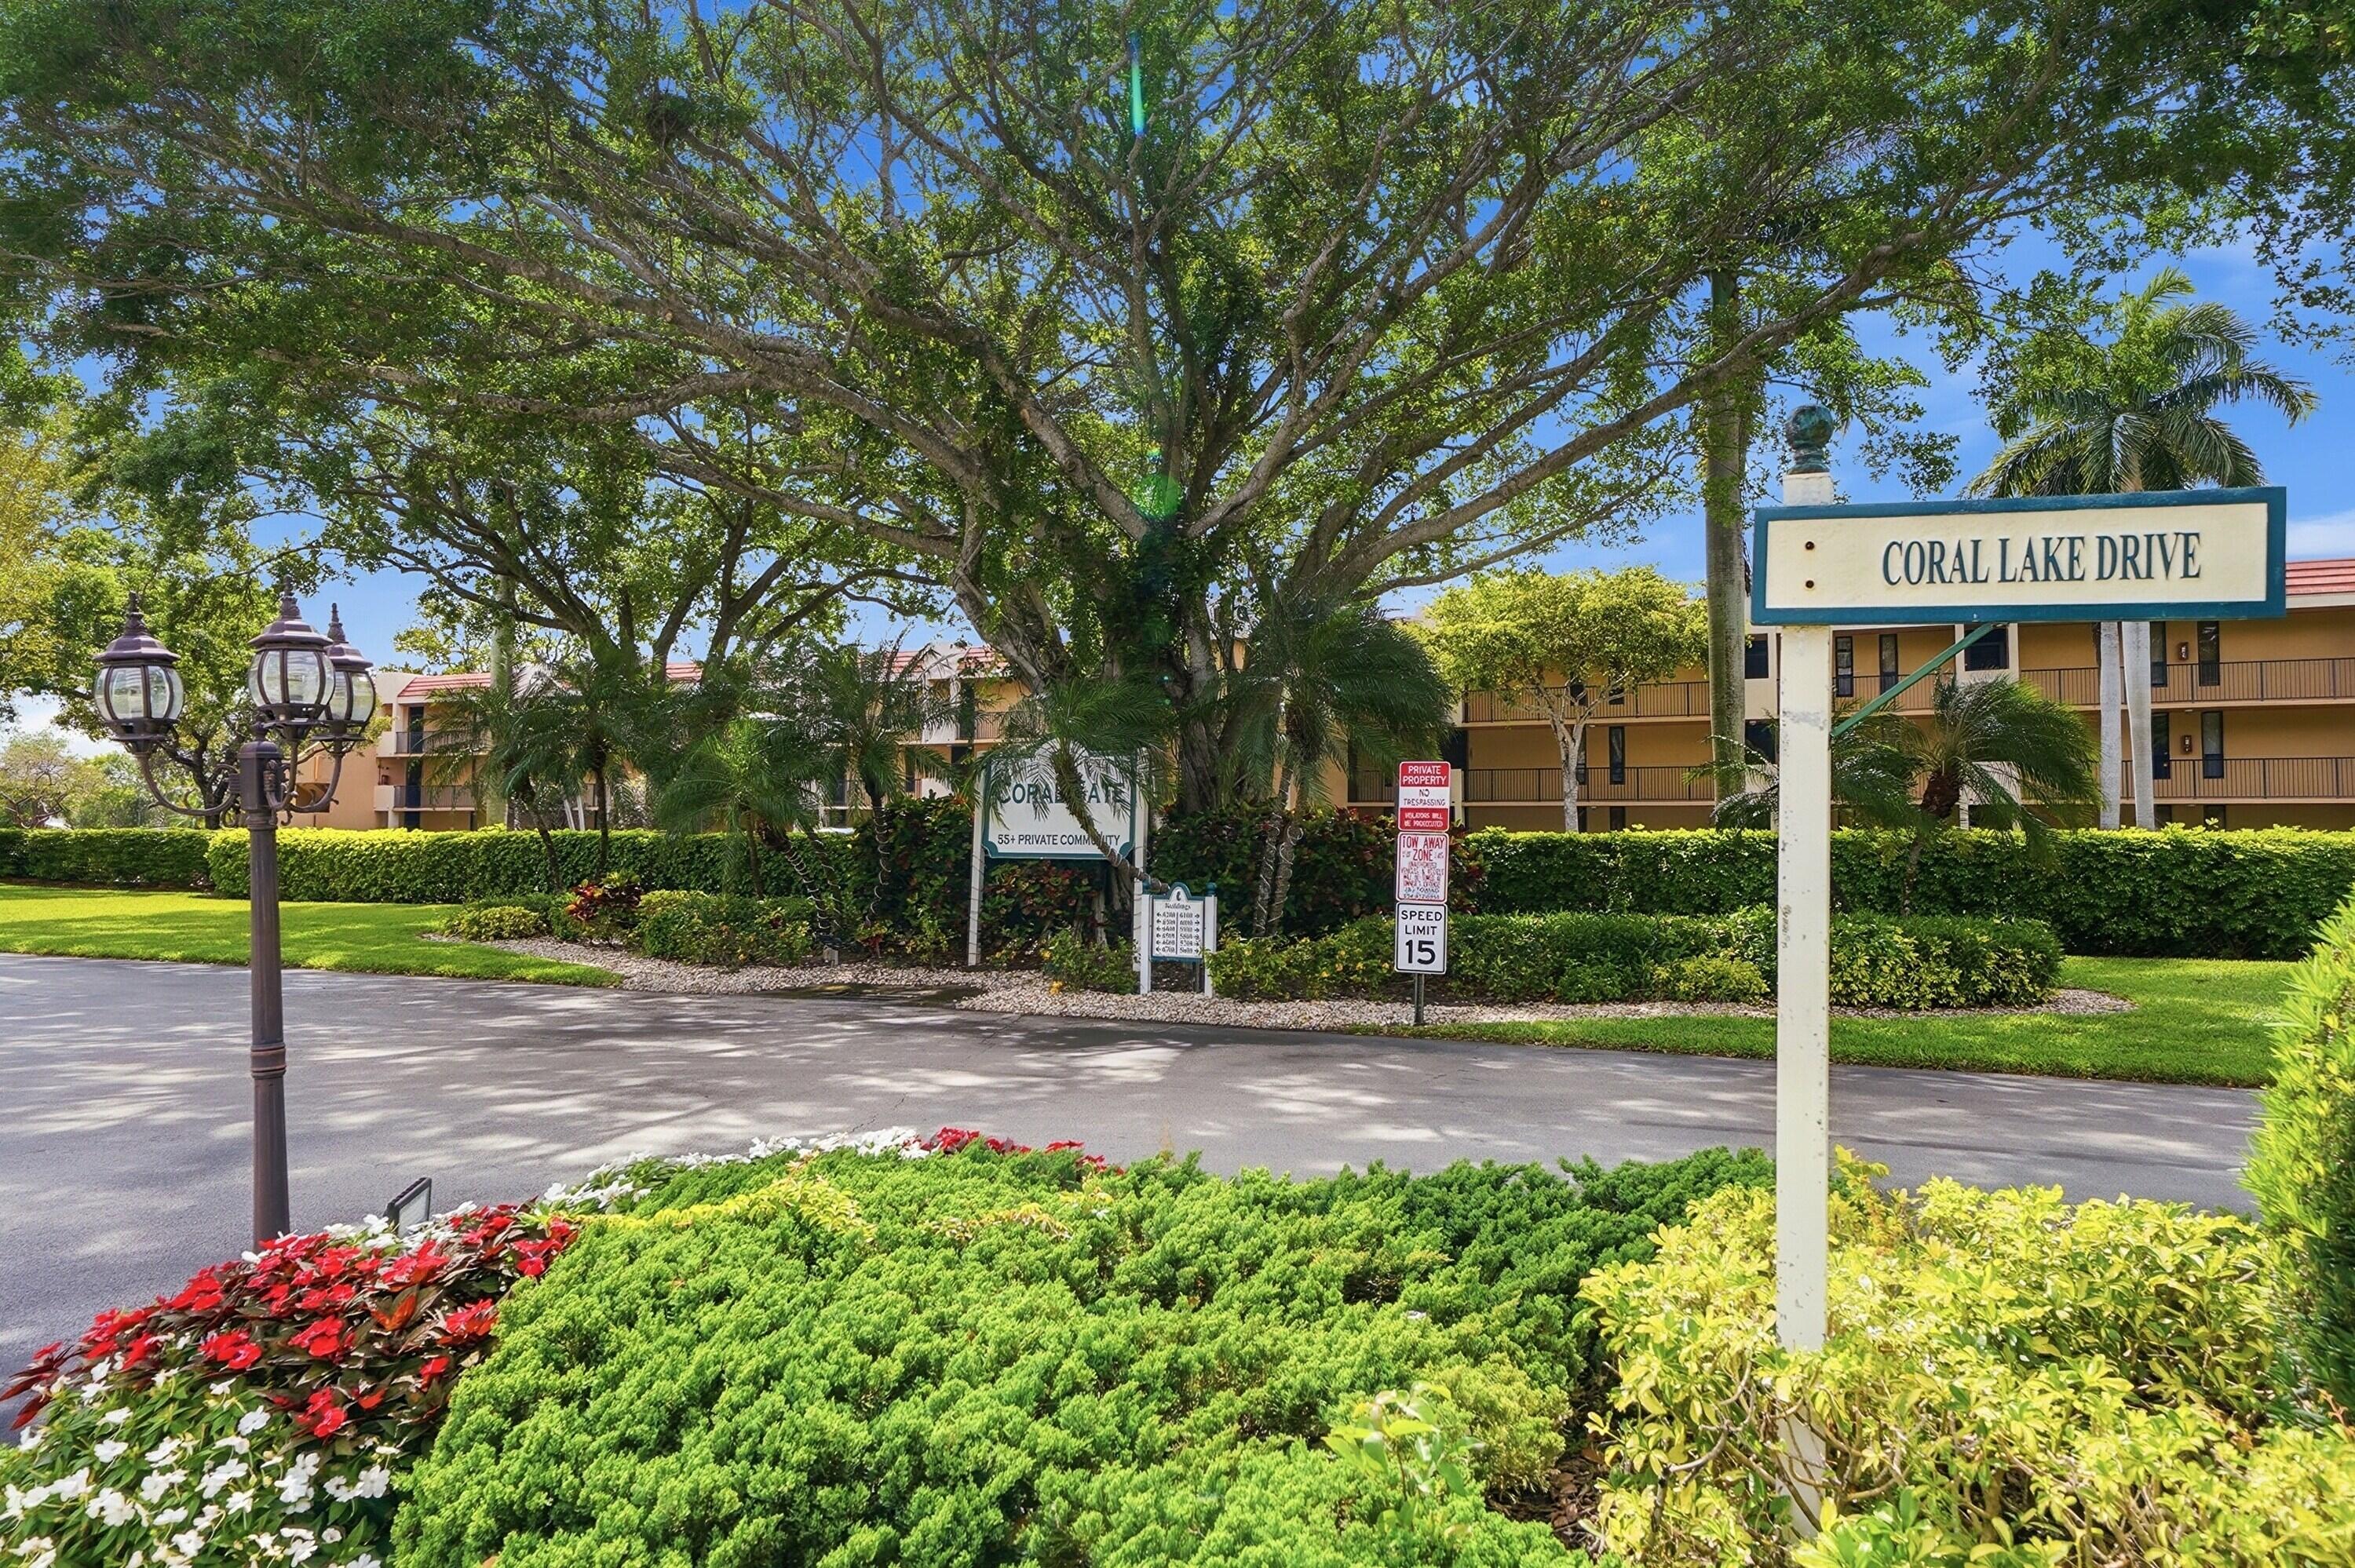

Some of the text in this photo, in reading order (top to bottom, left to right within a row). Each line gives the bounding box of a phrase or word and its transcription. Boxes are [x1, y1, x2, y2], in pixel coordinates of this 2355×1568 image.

[1882, 532, 2202, 585] CORAL LAKE DRIVE
[1408, 765, 1442, 775] PRIVATE
[1402, 775, 1447, 785] PROPERTY
[1418, 789, 1430, 797] NO
[998, 834, 1015, 844] 55+
[1018, 834, 1058, 845] PRIVATE
[1423, 837, 1445, 848] AWAY
[1413, 849, 1433, 861] ZONE
[1401, 910, 1442, 921] SPEED
[1405, 924, 1437, 935] LIMIT
[1405, 939, 1436, 965] 15
